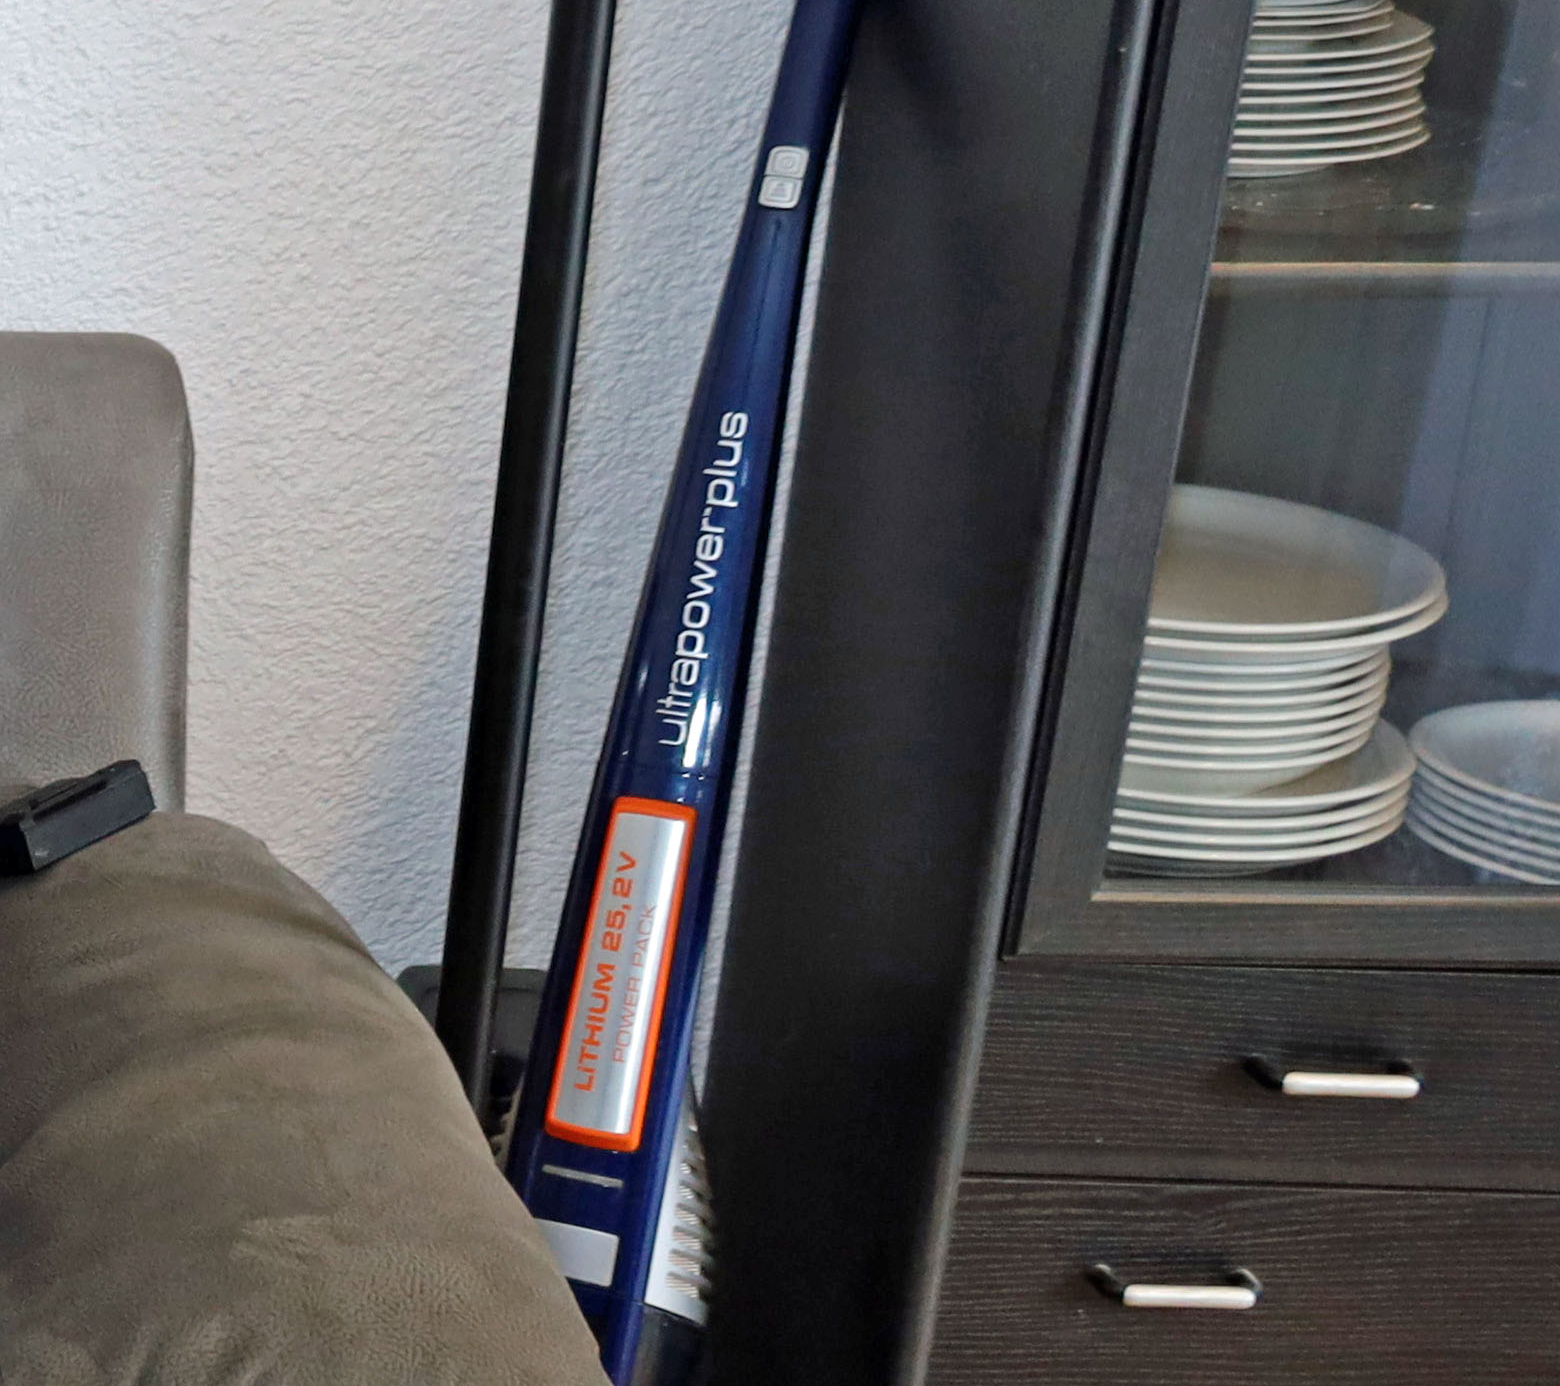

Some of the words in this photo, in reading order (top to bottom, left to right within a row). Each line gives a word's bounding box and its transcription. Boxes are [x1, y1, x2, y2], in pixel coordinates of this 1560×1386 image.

[655, 411, 749, 746] ultrapowerplus
[613, 976, 640, 1063] POWER
[632, 905, 657, 967] PACK
